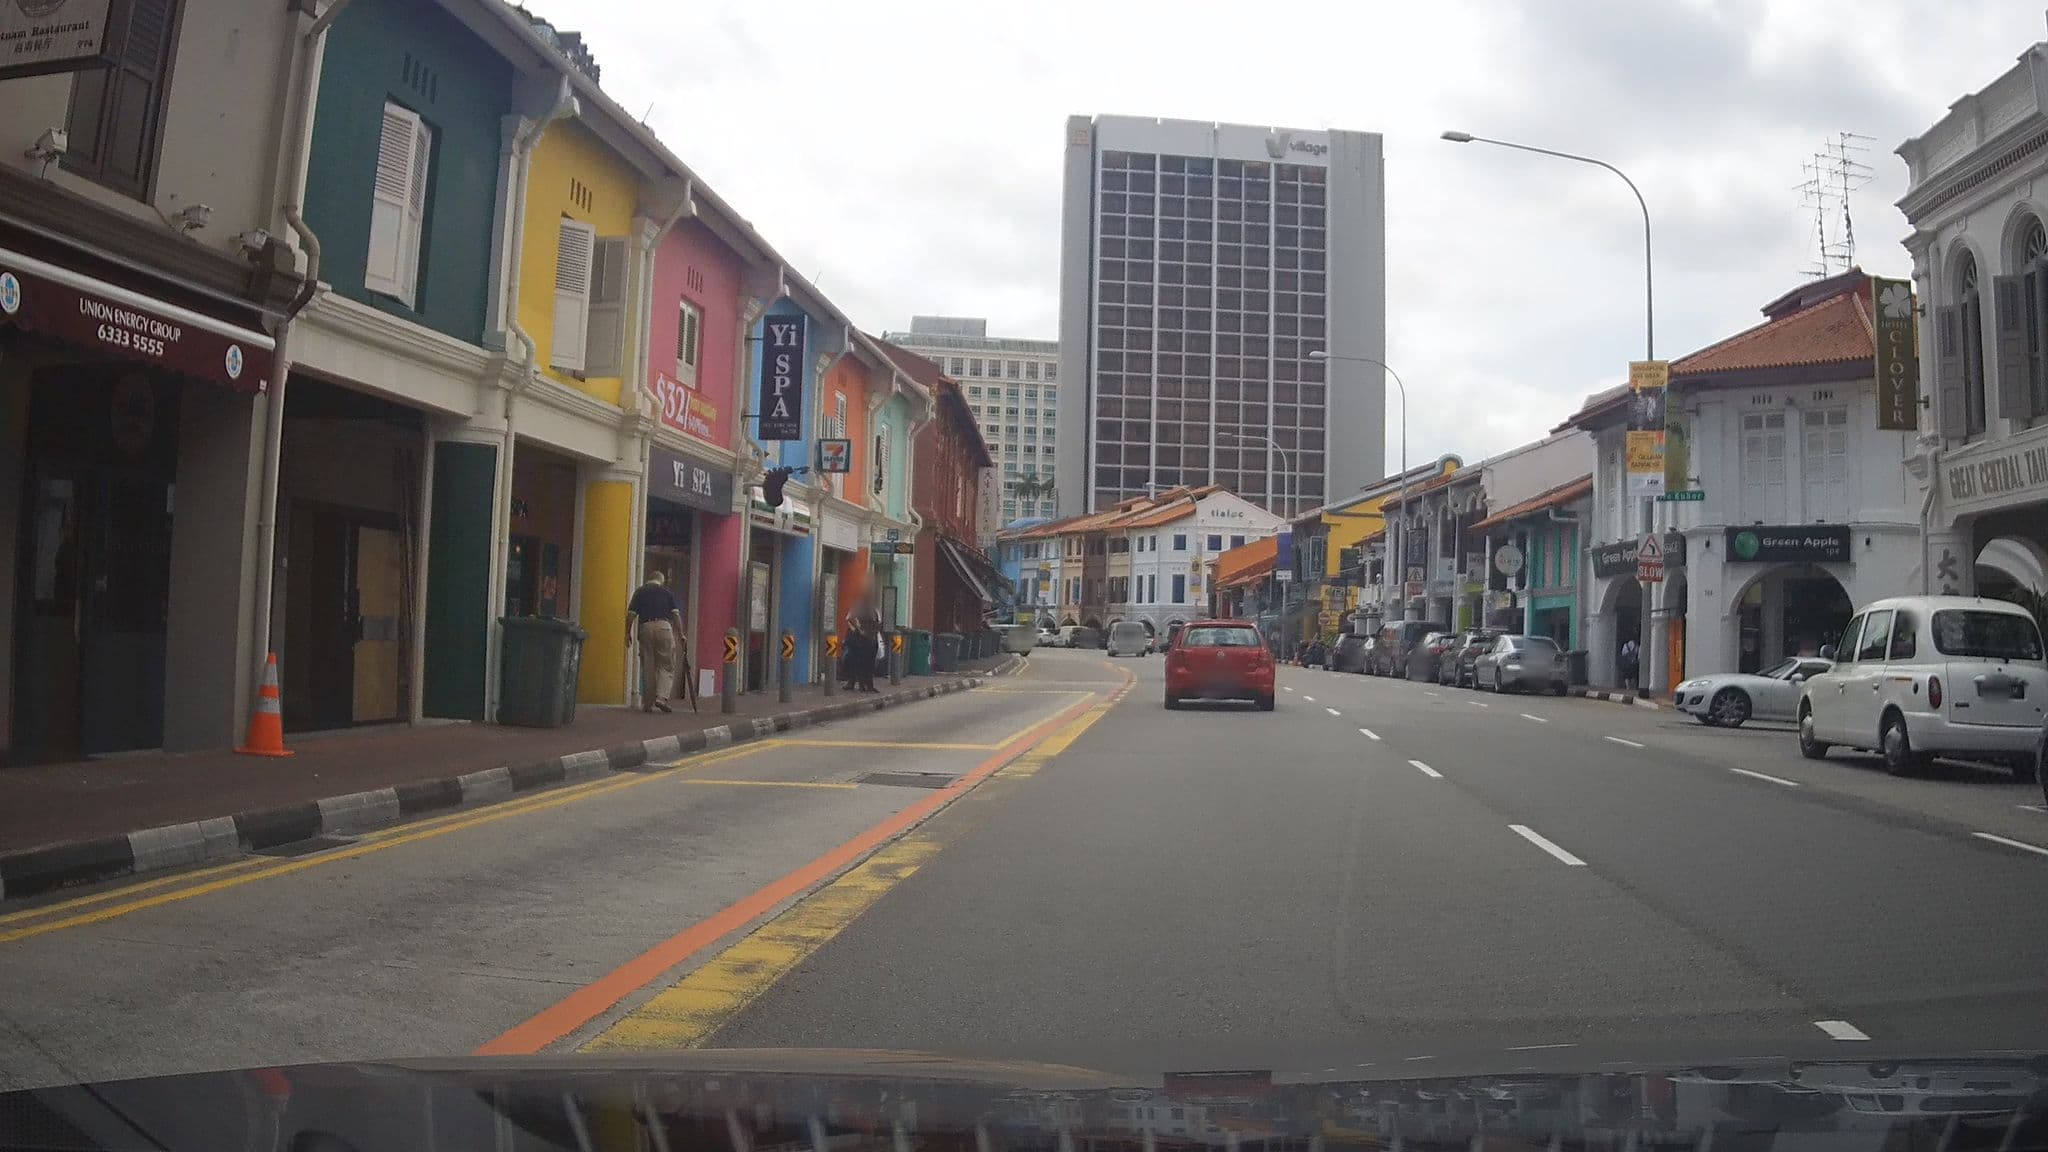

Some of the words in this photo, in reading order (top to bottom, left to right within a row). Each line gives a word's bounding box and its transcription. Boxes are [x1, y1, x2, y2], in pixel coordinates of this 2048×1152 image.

[31, 20, 89, 37] Restaurant
[80, 297, 113, 322] UNION
[114, 308, 149, 332] ENERGY
[150, 320, 180, 342] GROUP
[770, 323, 797, 346] Yi
[98, 324, 130, 347] 6333
[132, 333, 164, 356] 5555
[771, 353, 790, 417] SPA
[1889, 329, 1904, 424] CLOVER
[673, 460, 684, 488] Yi
[692, 467, 712, 496] SPA
[1949, 463, 1977, 498] GREAT
[1978, 454, 2024, 494] CENTRAL
[1622, 547, 1639, 563] Appl
[1762, 537, 1799, 547] Green
[1803, 537, 1839, 548] Apple
[1639, 565, 1664, 577] SLOW
